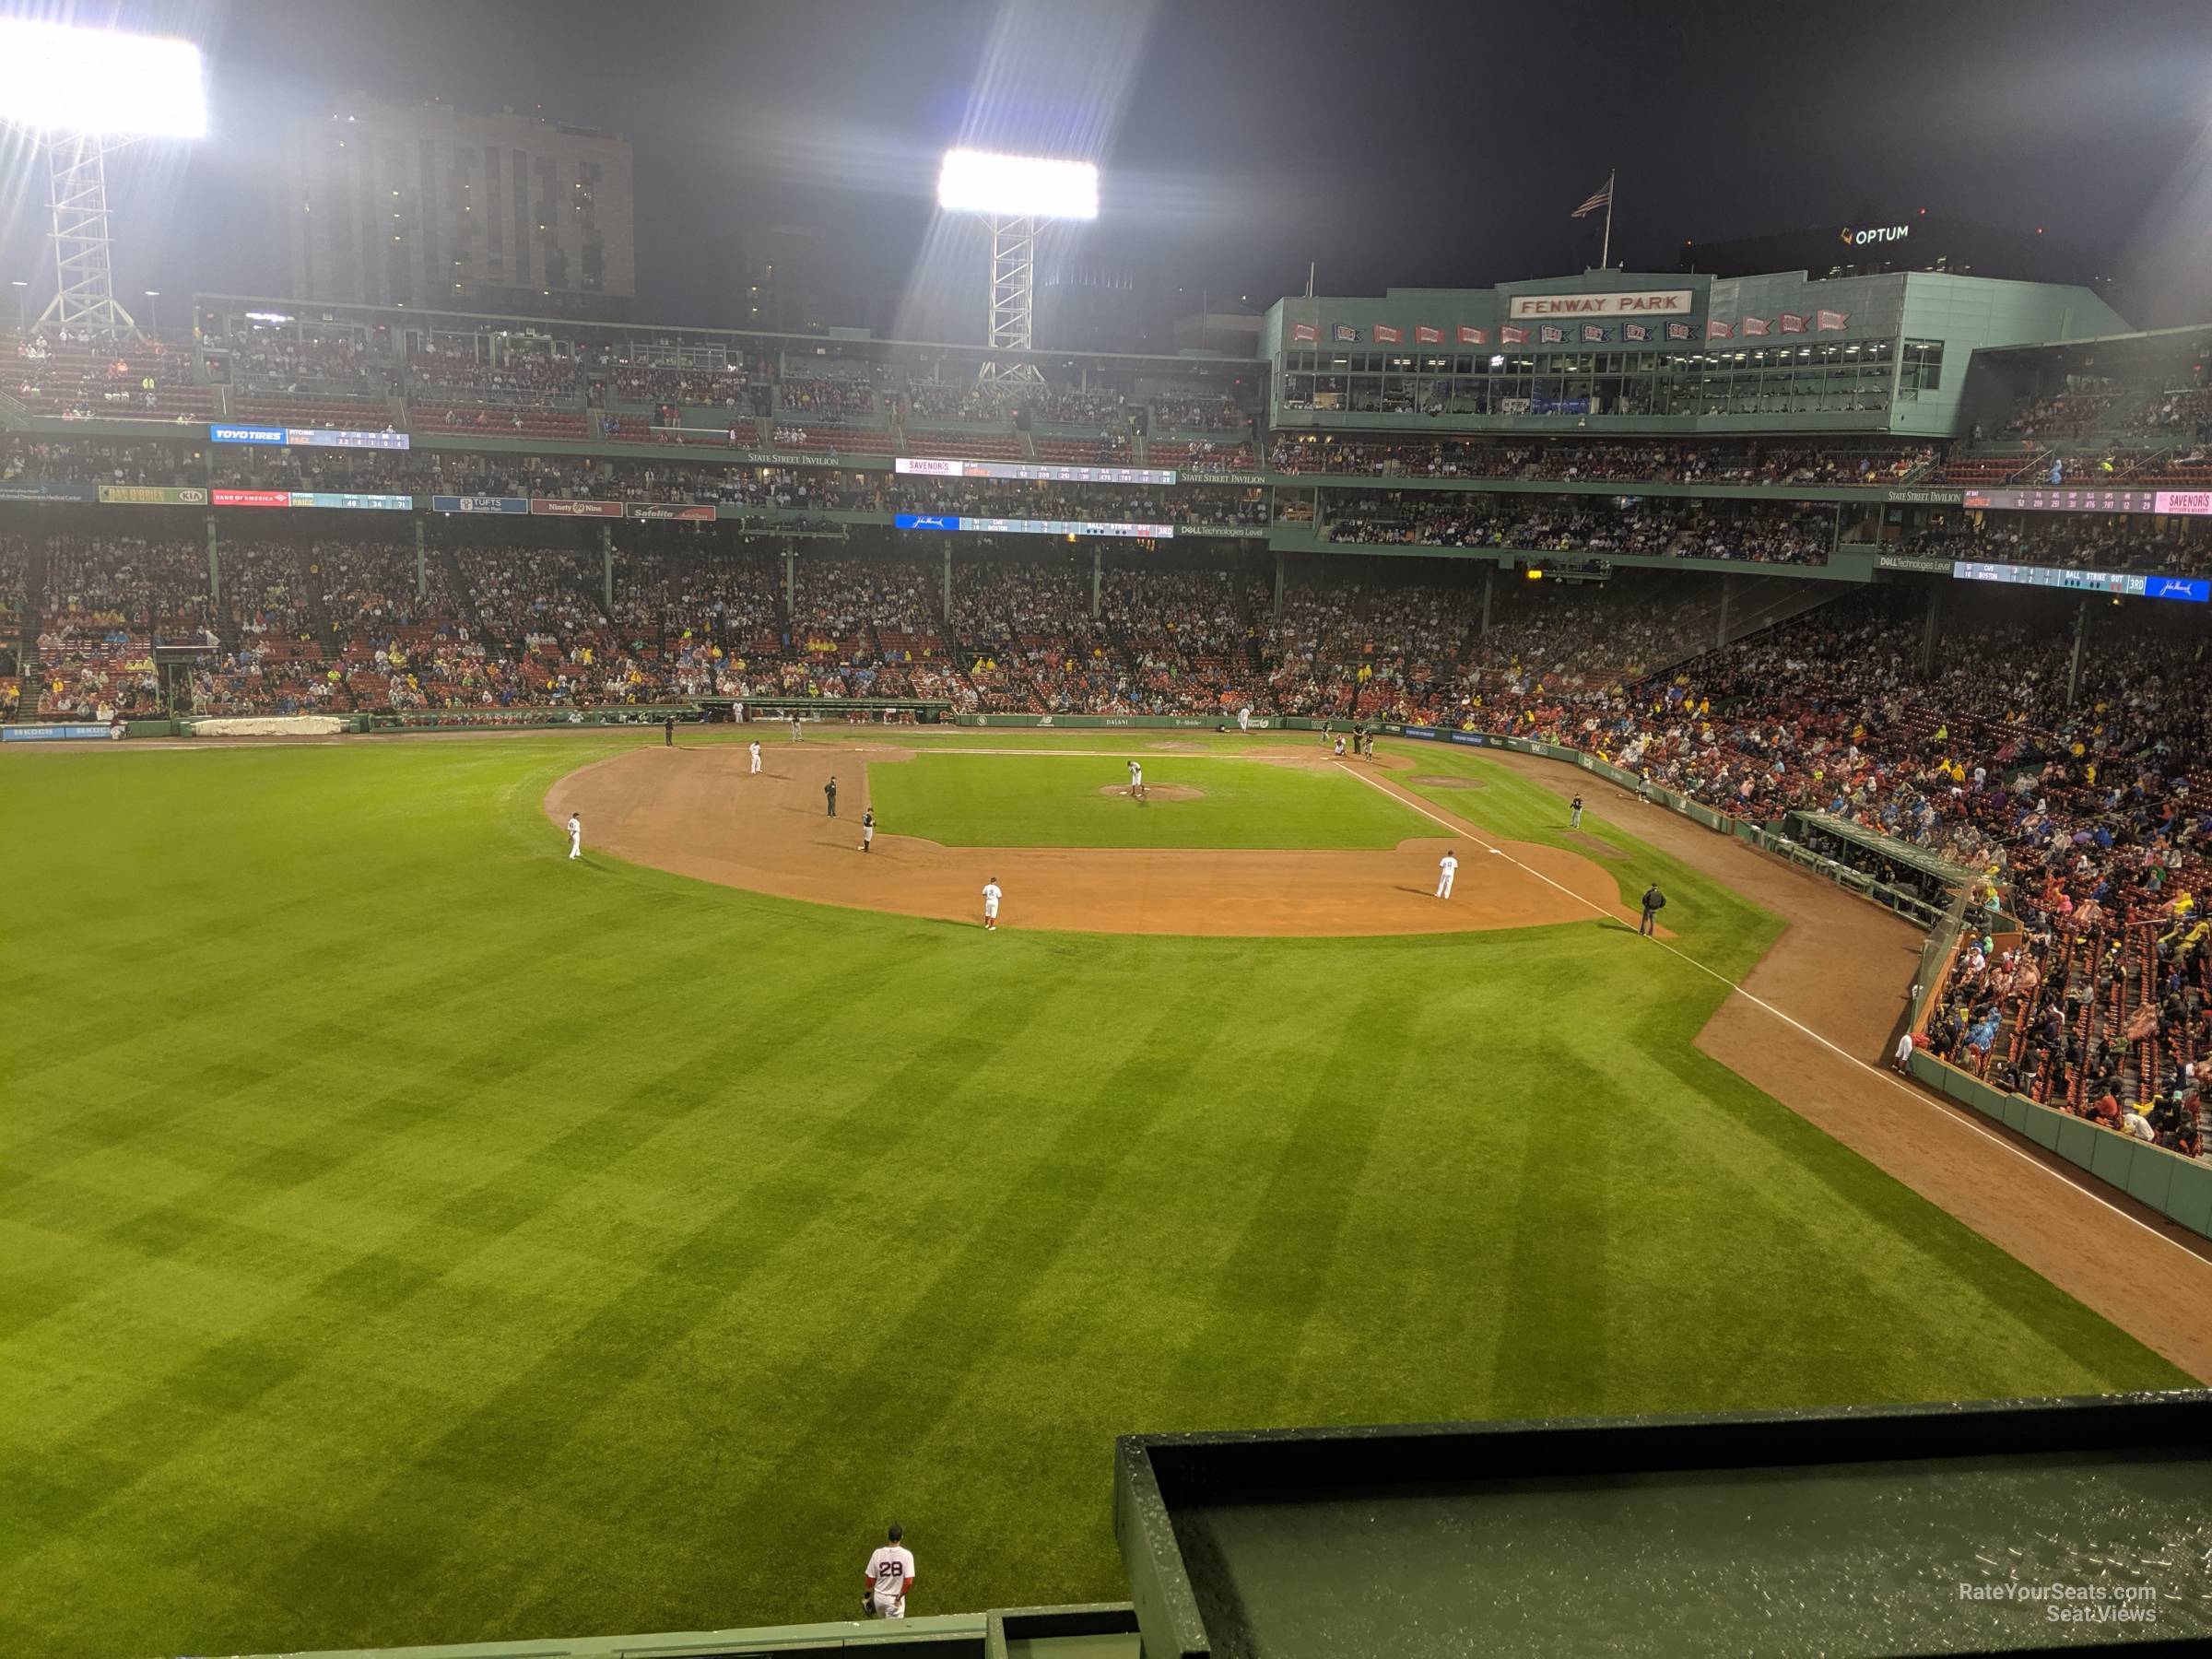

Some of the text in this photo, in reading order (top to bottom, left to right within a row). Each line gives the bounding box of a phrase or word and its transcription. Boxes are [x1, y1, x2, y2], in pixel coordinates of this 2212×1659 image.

[1855, 225, 1909, 244] OPTUM
[1521, 296, 1678, 314] FENWAY PARK
[216, 430, 281, 441] TOYO TIRES
[747, 453, 840, 465] STATE STREET PAVILION
[909, 461, 950, 471] SAVENOR'S
[1181, 473, 1265, 484] STATE STREET PAVILION
[182, 491, 200, 500] KIA
[1888, 490, 1961, 502] STATE STREET PAVILION
[2169, 494, 2210, 508] SAVENOR'S
[473, 498, 502, 507] TUFTS
[548, 503, 572, 512] Ninety
[634, 509, 674, 518] Safelite
[1181, 526, 1202, 535] DELL
[1201, 526, 1244, 536] Technologies
[1880, 557, 1951, 571] DELL Technologies Level
[1978, 571, 1998, 580] BOSTON
[2065, 571, 2080, 579] BALL
[2087, 572, 2107, 582] STRIKE
[2111, 574, 2124, 583] OUT
[2129, 578, 2144, 591] 3RD
[879, 1561, 902, 1577] 28
